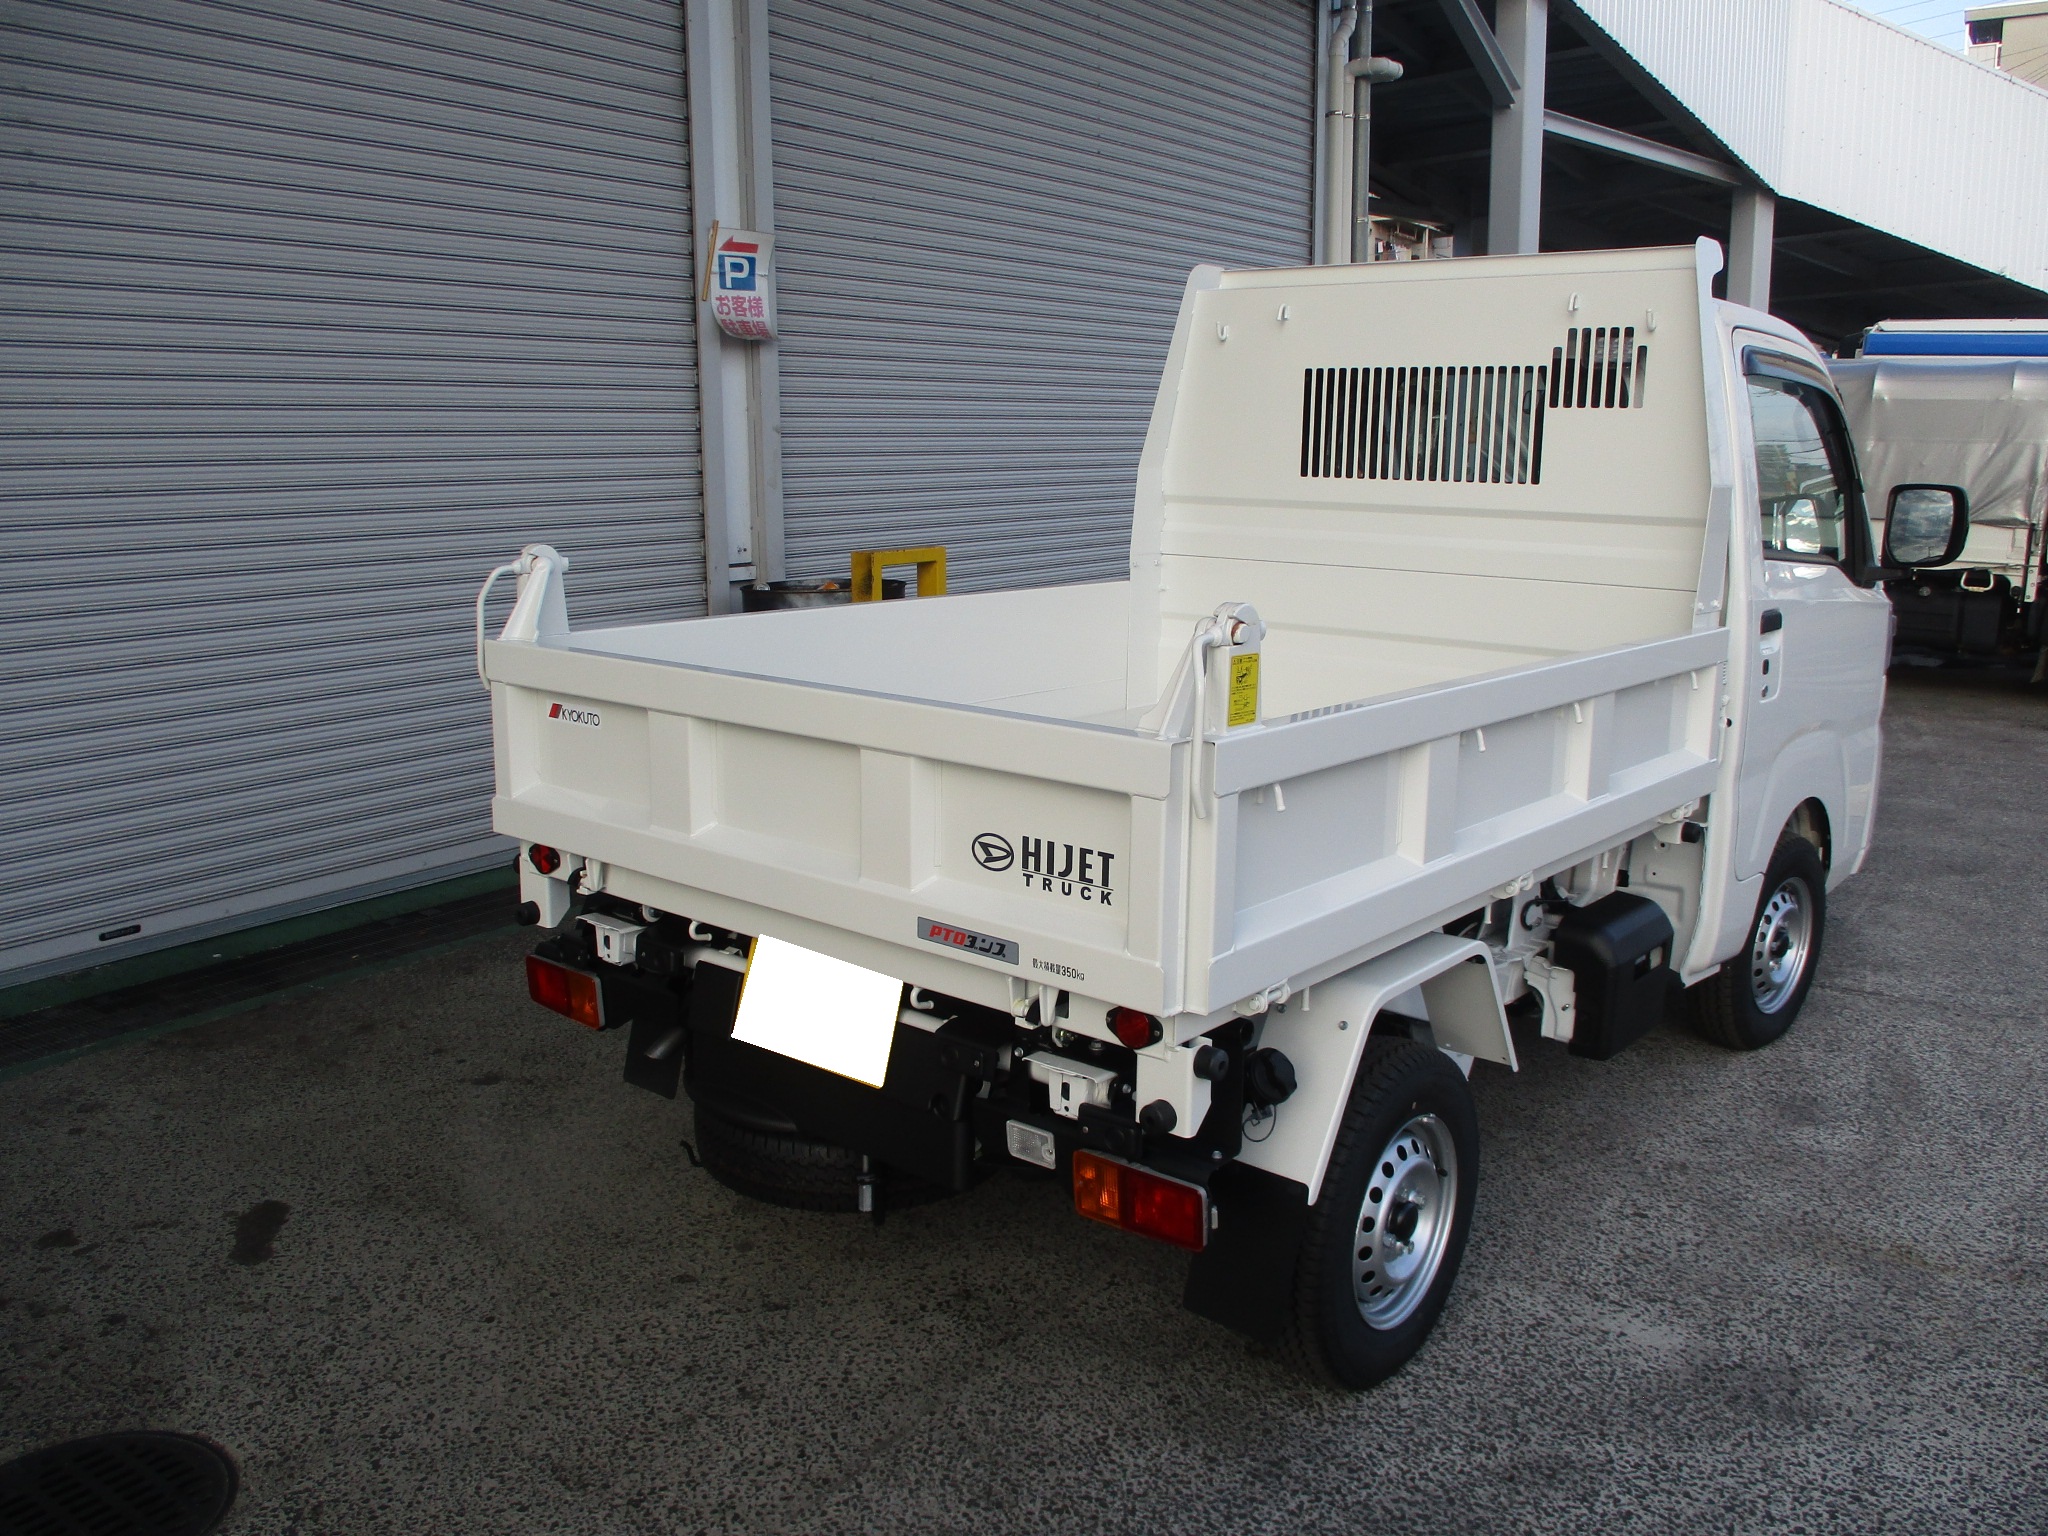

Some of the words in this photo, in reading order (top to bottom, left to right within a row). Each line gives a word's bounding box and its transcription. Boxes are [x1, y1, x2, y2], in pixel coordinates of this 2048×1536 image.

[724, 256, 750, 289] P
[715, 294, 765, 318] お客様
[561, 707, 601, 727] KYOKUTO
[1021, 835, 1115, 888] HIJET
[1022, 872, 1112, 906] TRUCK
